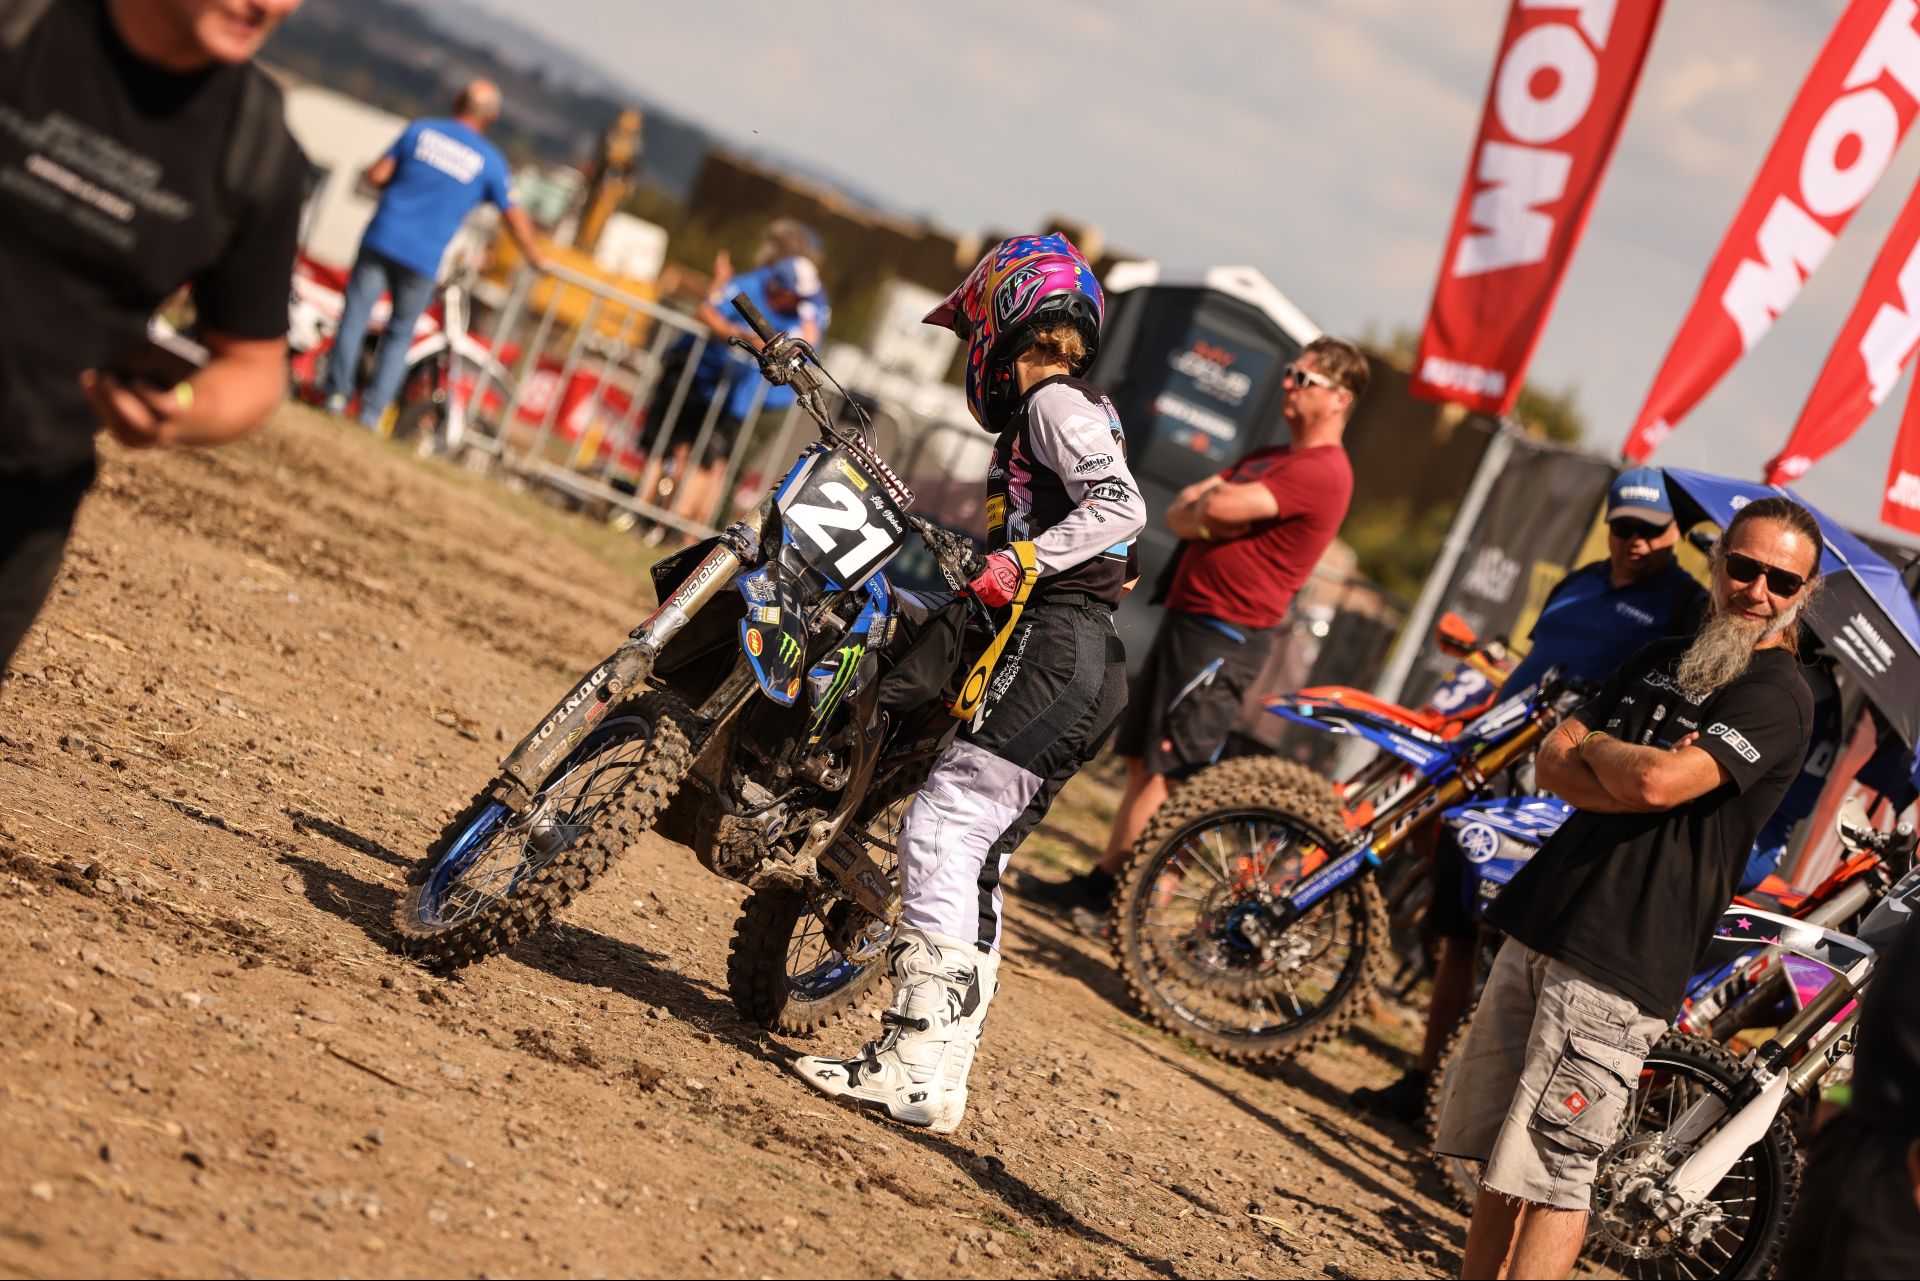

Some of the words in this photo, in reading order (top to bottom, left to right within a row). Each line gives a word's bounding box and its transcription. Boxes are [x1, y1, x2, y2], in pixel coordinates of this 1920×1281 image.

[785, 482, 894, 579] 21
[528, 664, 609, 752] DUNLOP
[1432, 669, 1486, 712] 3
